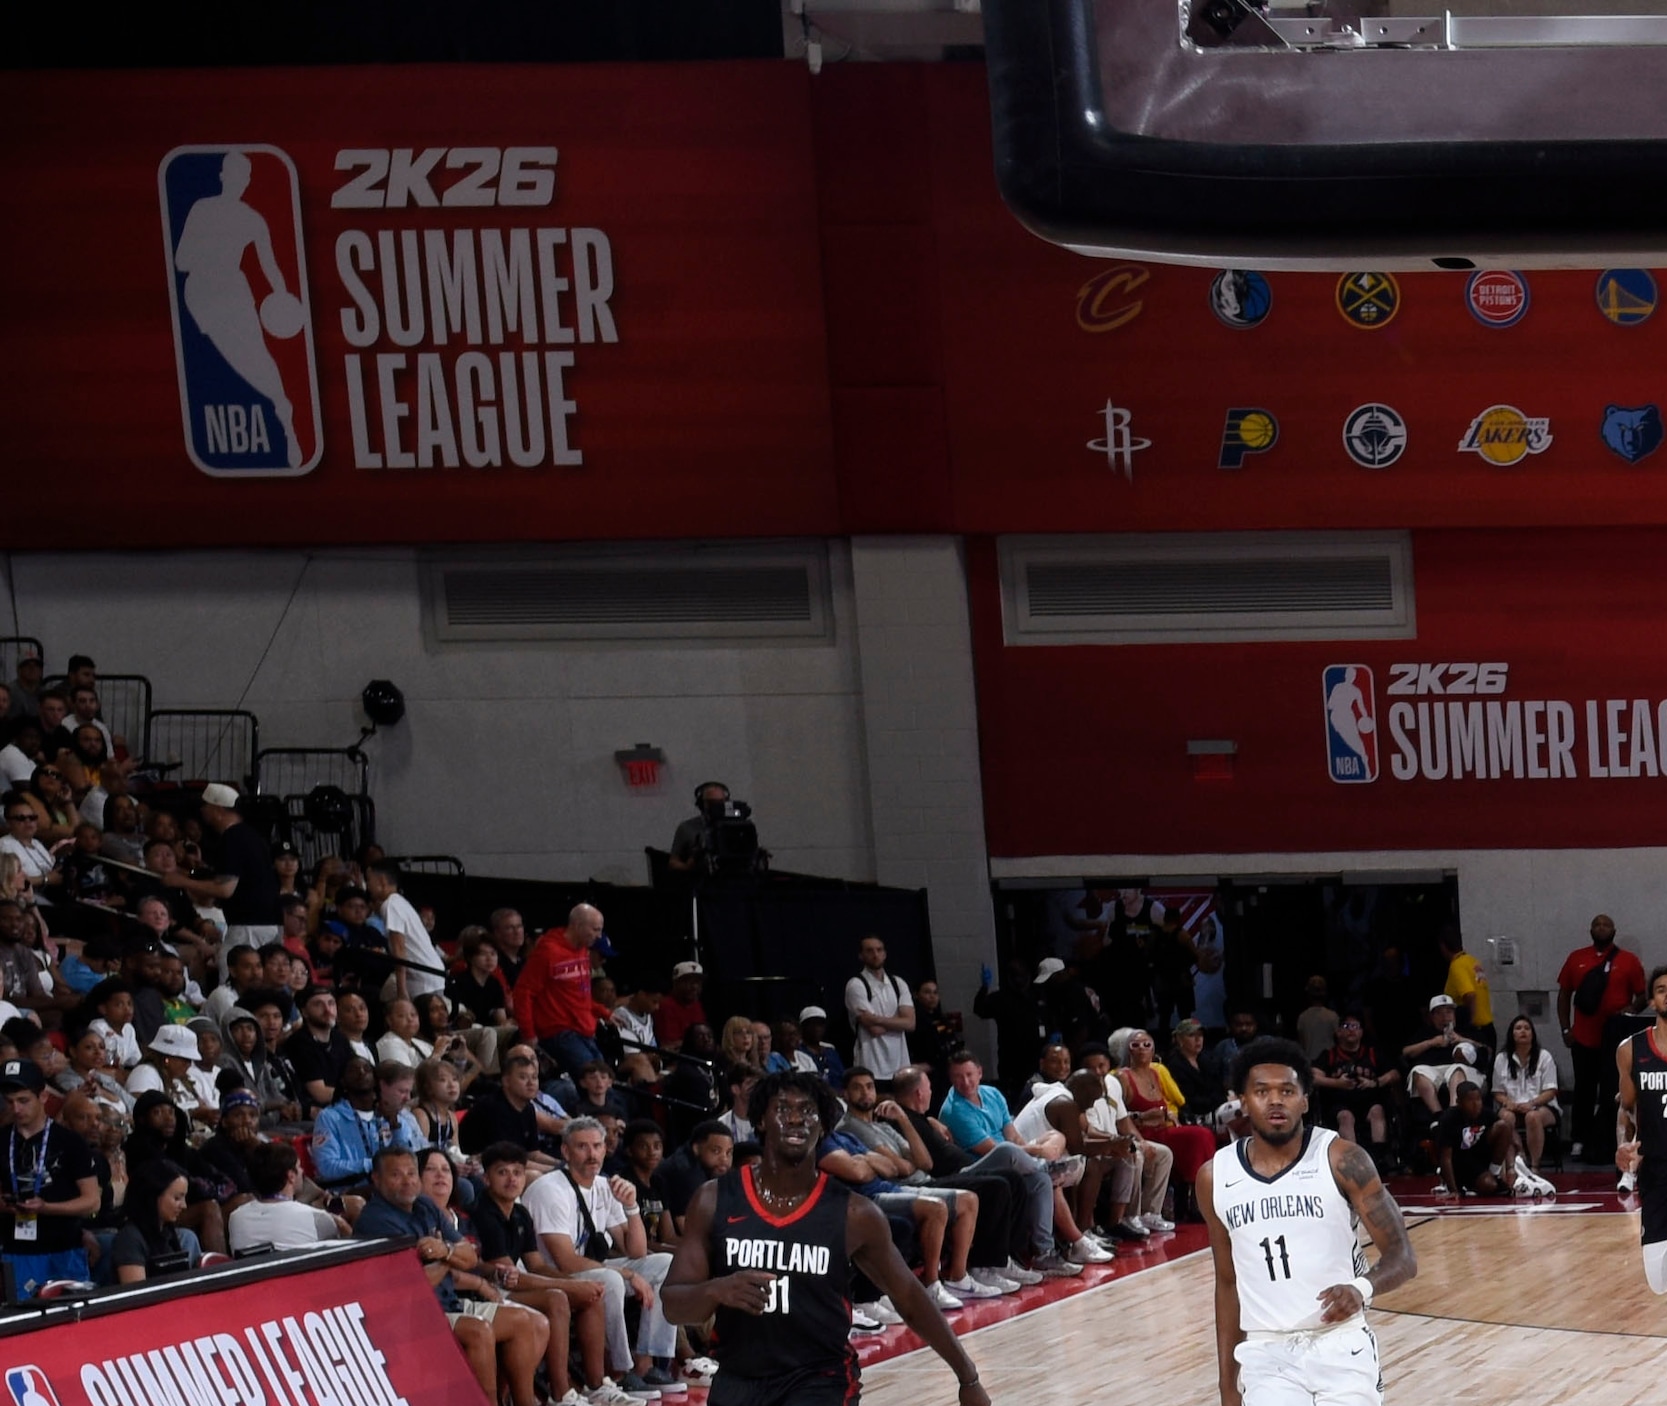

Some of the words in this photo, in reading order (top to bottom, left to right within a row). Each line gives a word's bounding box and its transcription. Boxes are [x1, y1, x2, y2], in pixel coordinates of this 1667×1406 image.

[331, 146, 558, 208] 2K26
[335, 226, 619, 348] SUMMER
[1479, 295, 1517, 306] PISTONS
[204, 404, 271, 454] NBA
[345, 351, 583, 469] LEAGUE
[1466, 420, 1544, 449] LAKERS
[1387, 663, 1509, 696] 2K26
[1389, 700, 1576, 780] SUMMER
[1335, 756, 1360, 777] NBA
[1226, 1200, 1256, 1231] NEW
[1260, 1194, 1325, 1221] ORLEANS
[725, 1237, 830, 1275] PORTLAND
[1259, 1235, 1292, 1282] 11
